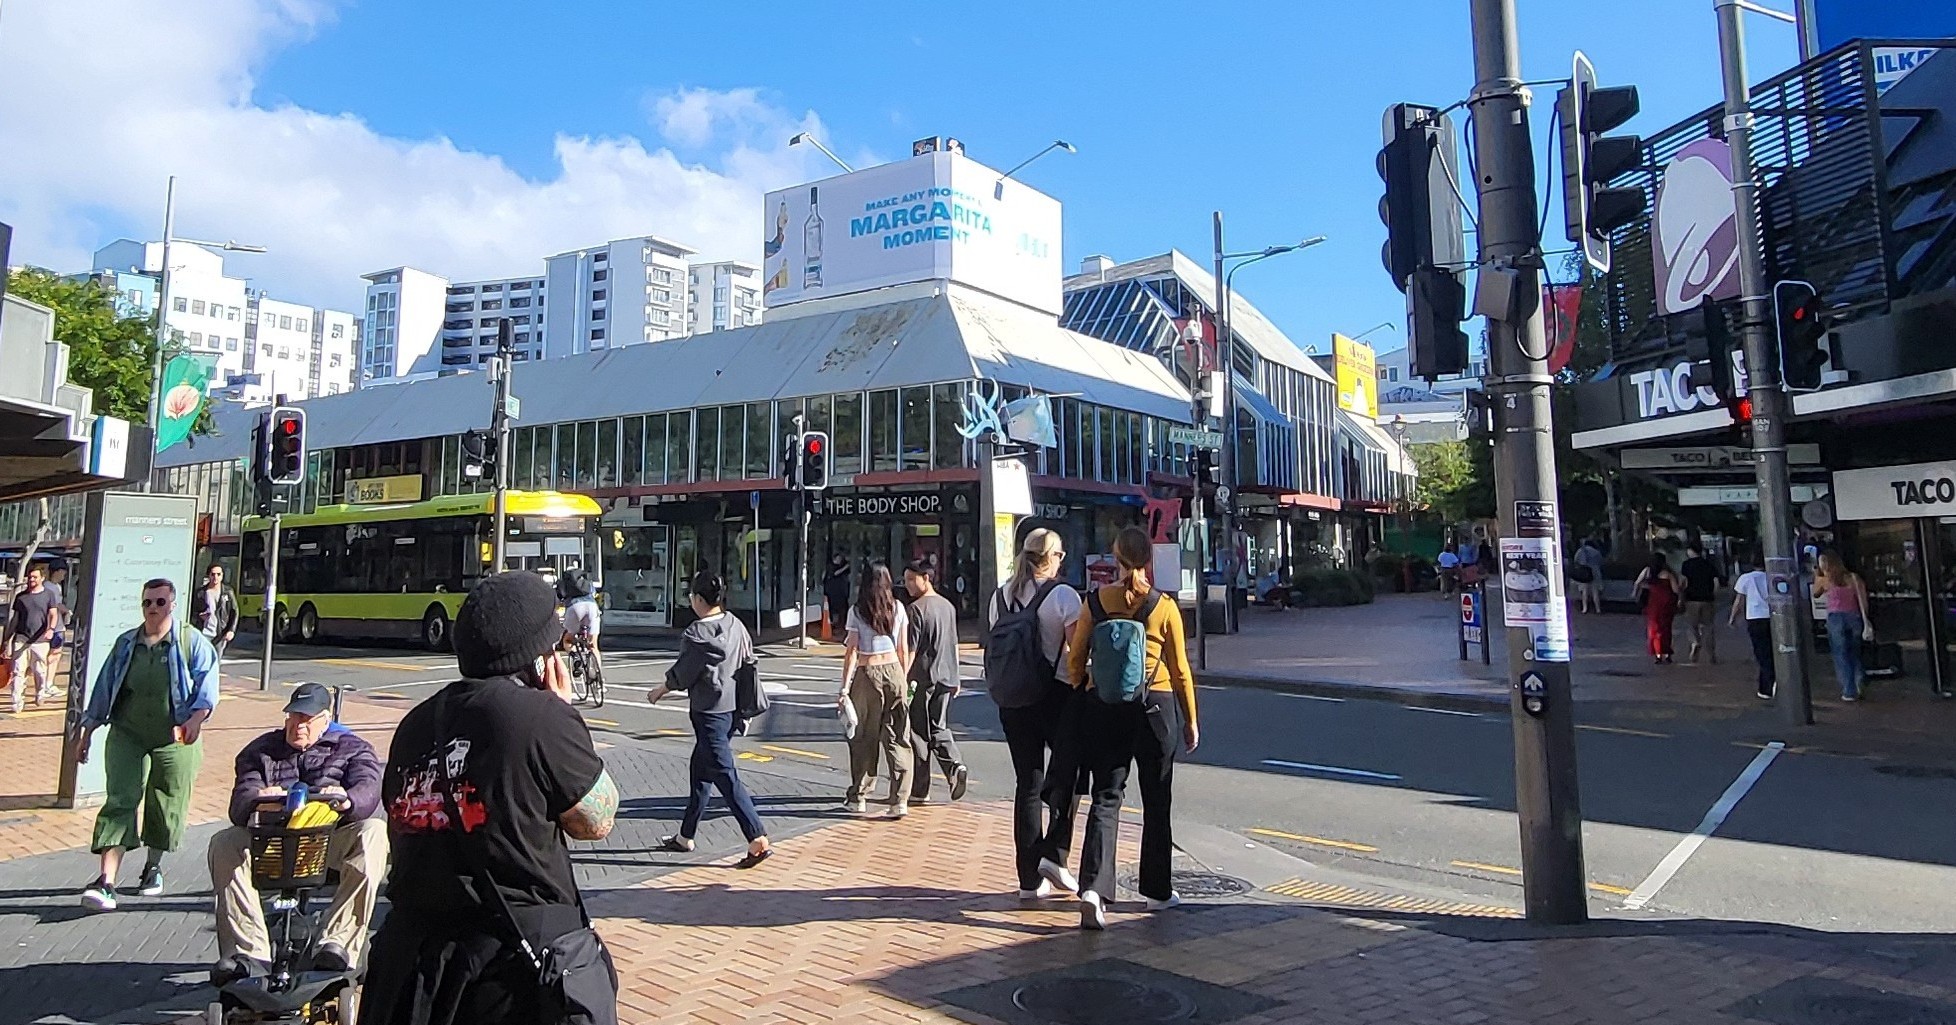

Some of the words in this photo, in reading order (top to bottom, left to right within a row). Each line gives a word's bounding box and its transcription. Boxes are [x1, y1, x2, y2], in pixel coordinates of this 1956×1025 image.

[865, 197, 898, 212] MAKE
[901, 190, 926, 204] ANY
[850, 201, 992, 239] MARGARITA
[883, 226, 970, 250] MOMENT
[1671, 453, 1705, 463] TACO
[1890, 477, 1955, 506] TACO
[828, 498, 854, 515] THE
[858, 498, 898, 514] BODY
